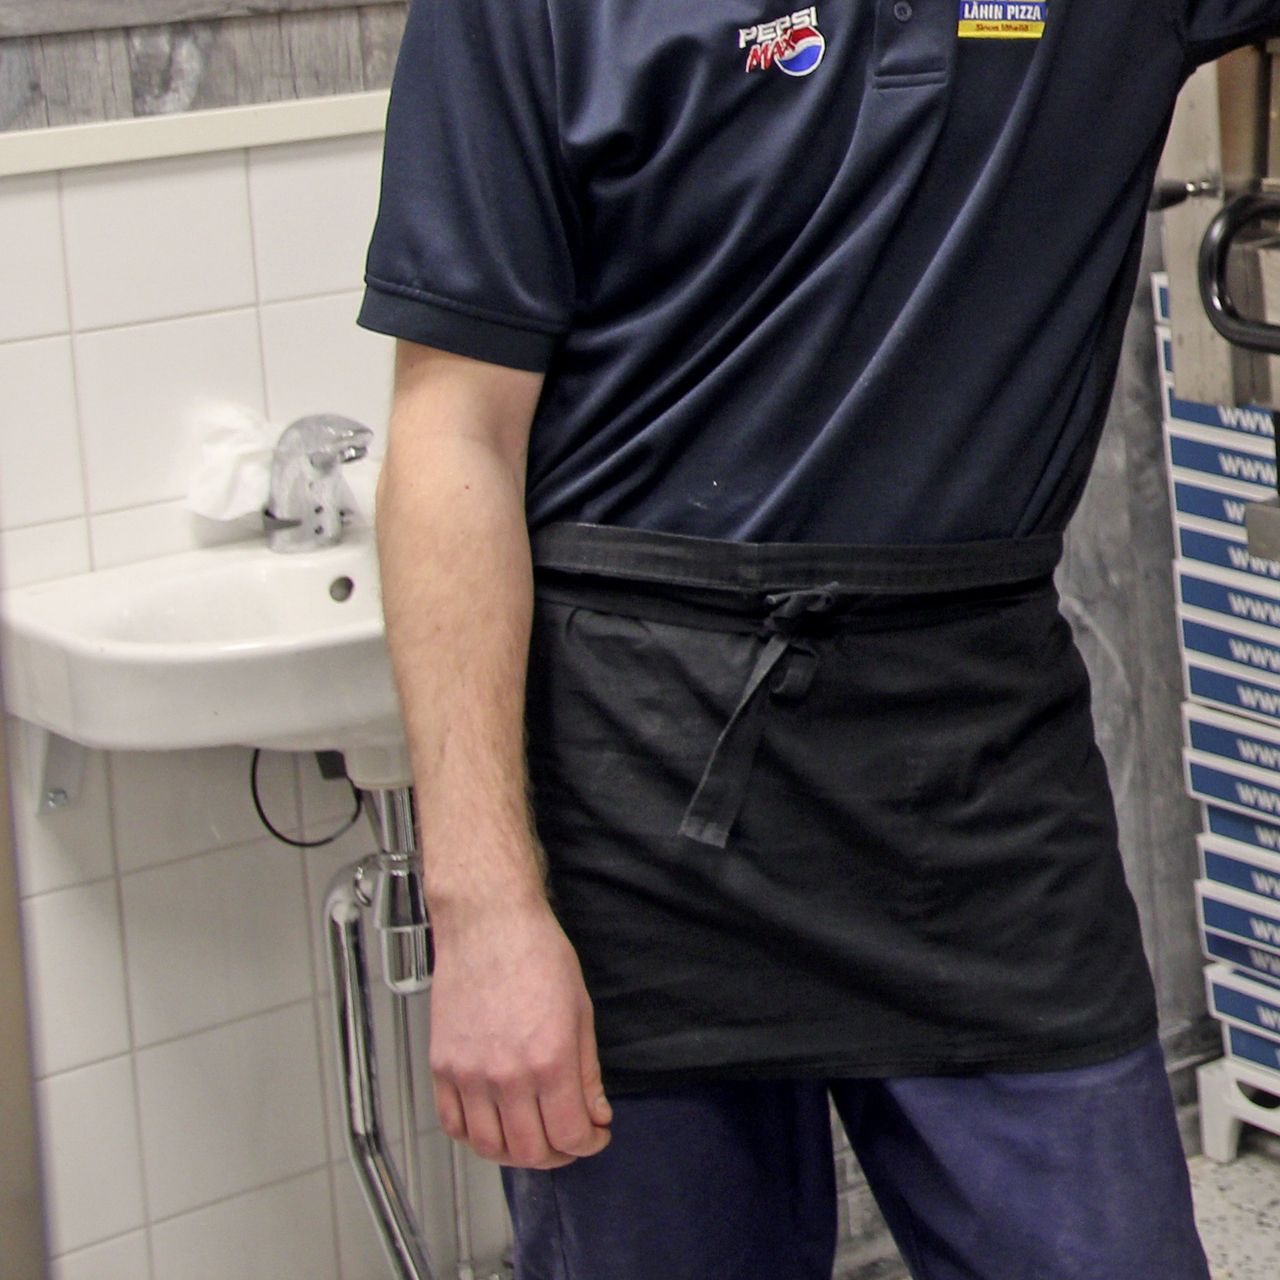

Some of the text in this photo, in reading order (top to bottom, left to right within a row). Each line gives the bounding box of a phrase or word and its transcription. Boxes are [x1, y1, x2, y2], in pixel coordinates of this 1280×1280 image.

[738, 6, 819, 50] PEPSI
[1006, 4, 1042, 21] PIZZA
[746, 31, 798, 74] MAX
